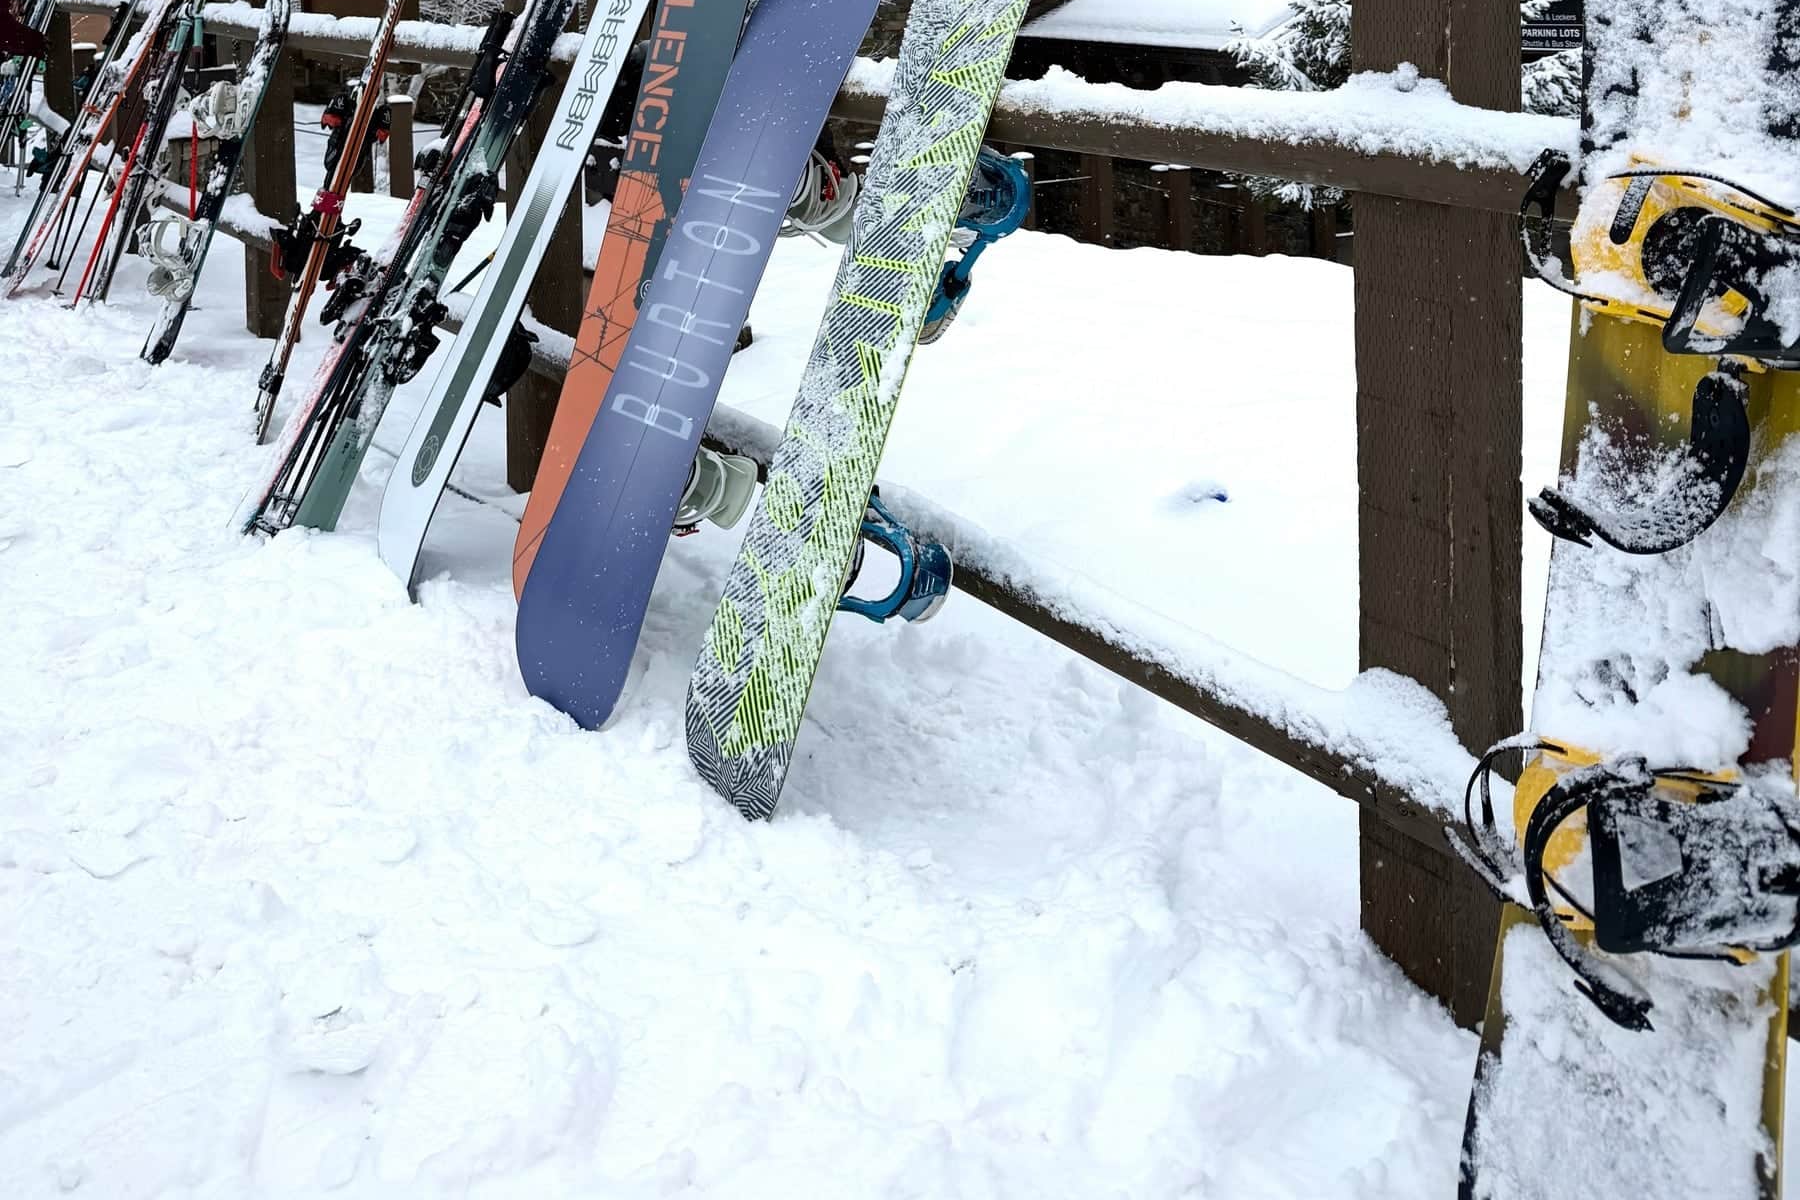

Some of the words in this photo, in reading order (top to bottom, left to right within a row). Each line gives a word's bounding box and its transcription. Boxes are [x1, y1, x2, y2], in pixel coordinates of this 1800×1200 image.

[1552, 13, 1576, 21] Lockers
[1521, 28, 1558, 37] PARKING
[1560, 29, 1580, 37] LOTS
[1544, 39, 1551, 47] &
[611, 174, 781, 440] BURTON
